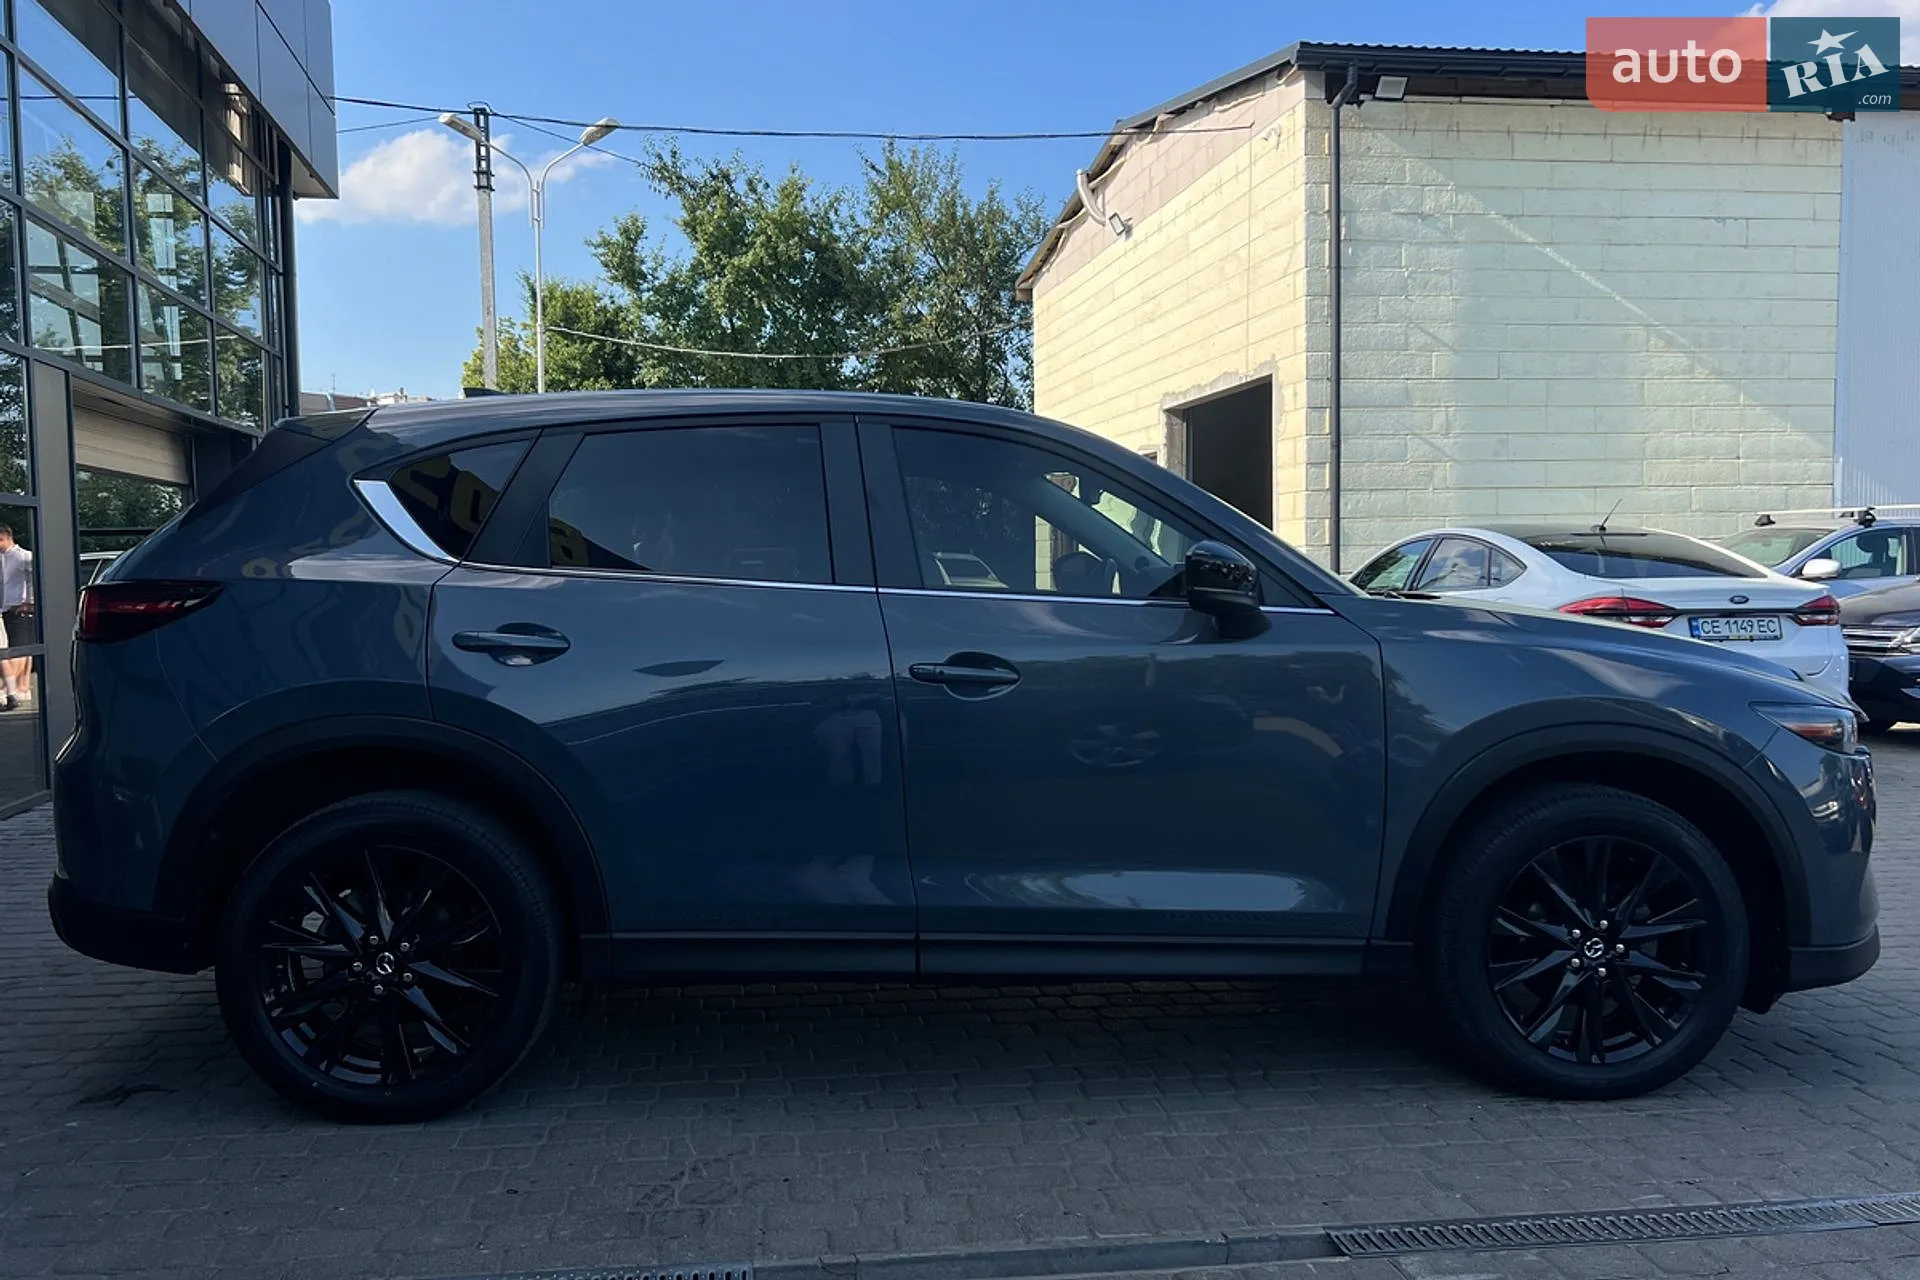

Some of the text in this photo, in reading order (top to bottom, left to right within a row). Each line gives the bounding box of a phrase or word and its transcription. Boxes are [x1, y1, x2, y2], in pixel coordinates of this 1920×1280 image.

[1701, 619, 1776, 634] CE 1149 EC
